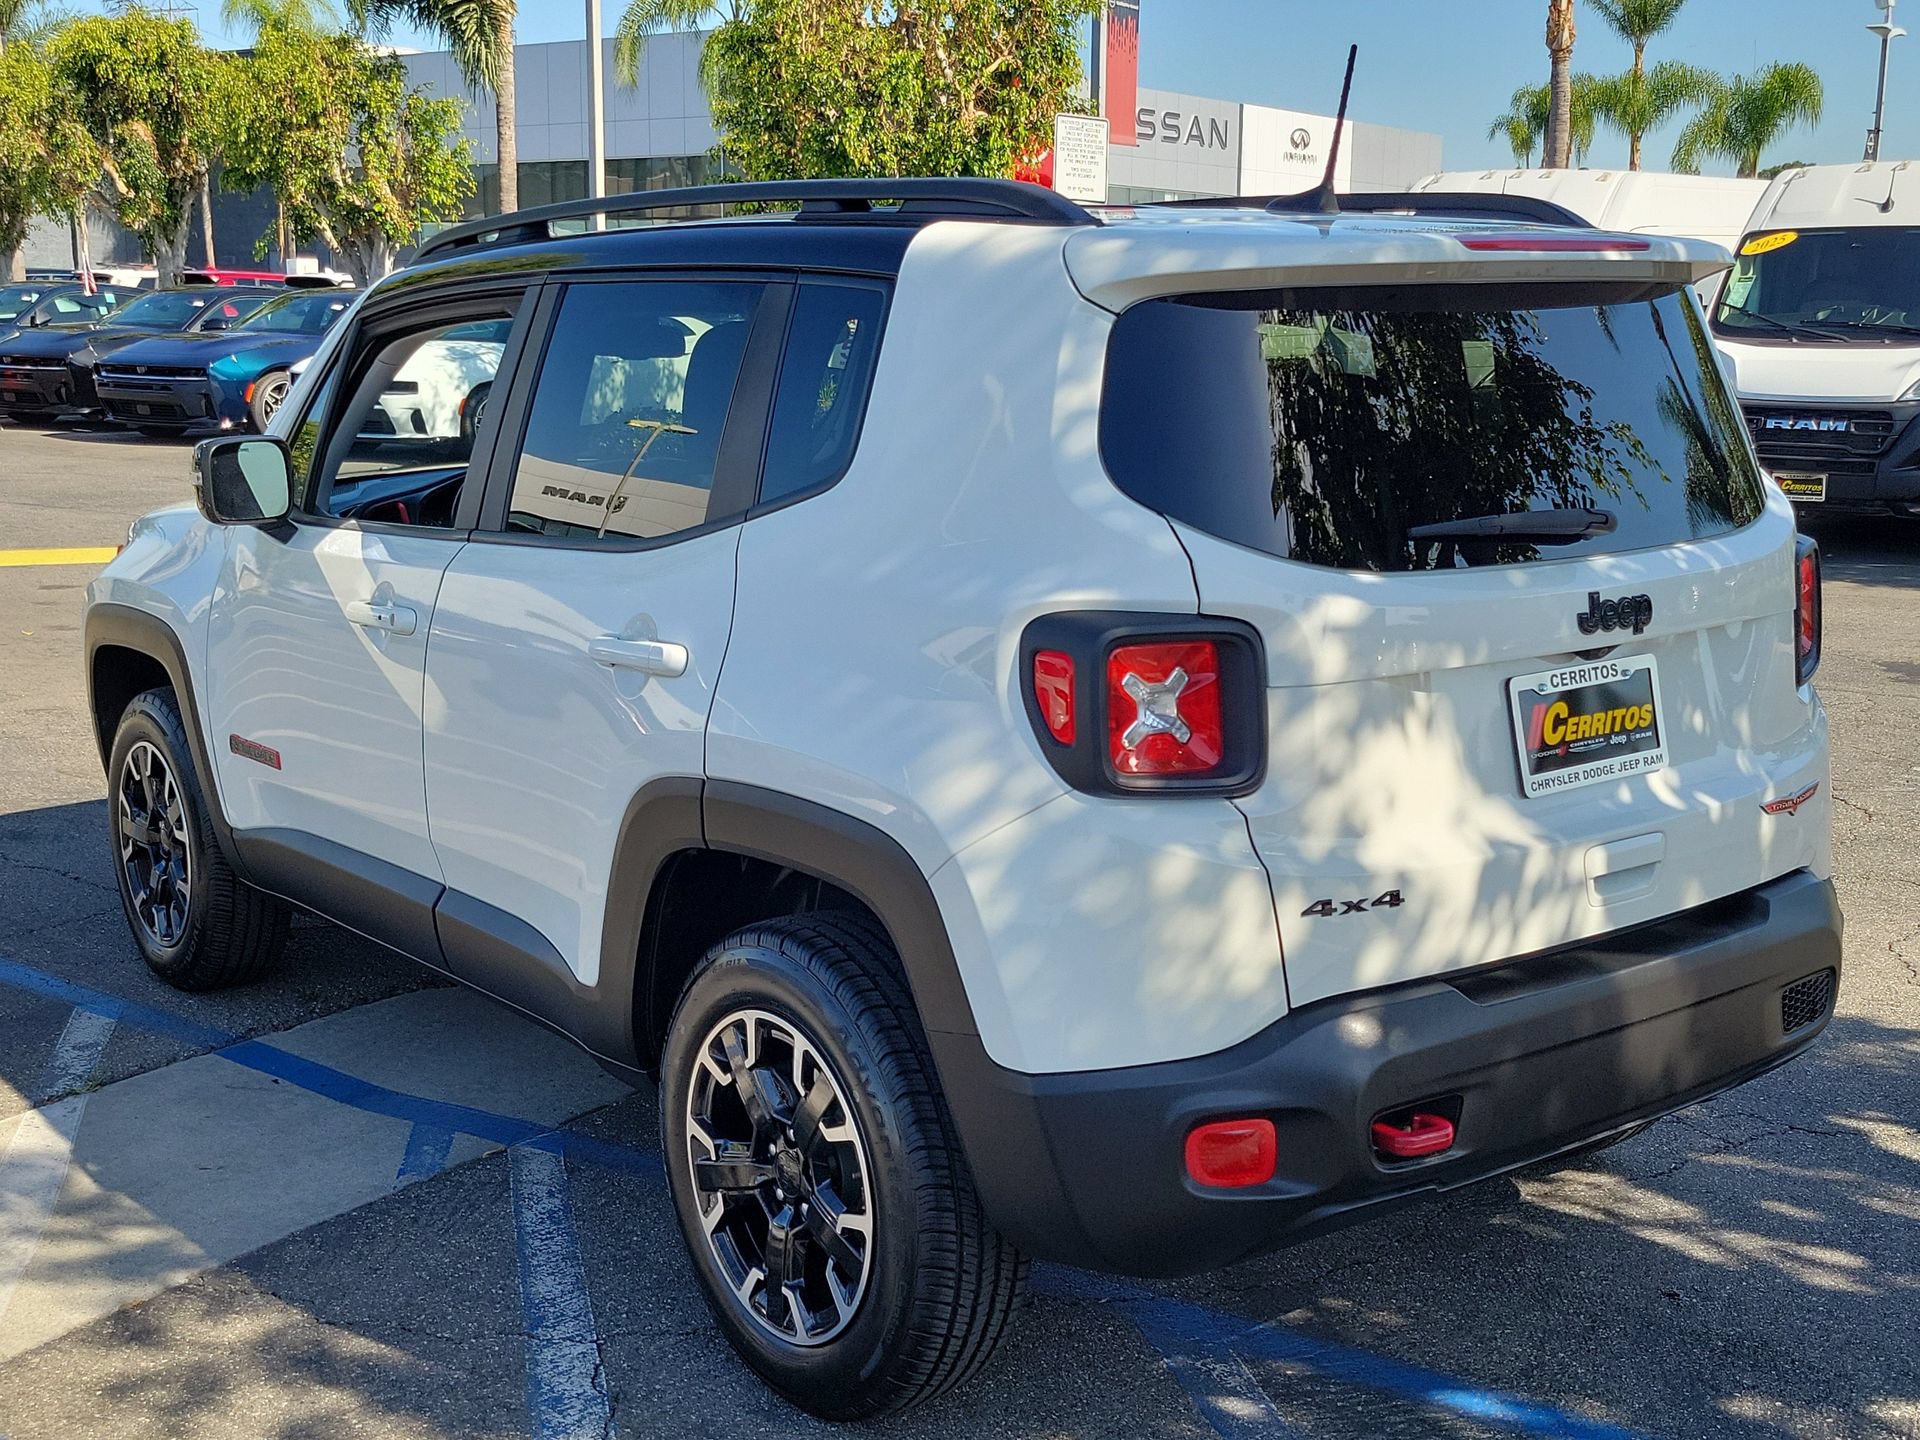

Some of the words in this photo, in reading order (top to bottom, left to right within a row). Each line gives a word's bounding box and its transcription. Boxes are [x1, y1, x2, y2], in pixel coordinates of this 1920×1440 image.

[1136, 107, 1229, 151] SSAN
[1751, 234, 1787, 252] 2025
[1765, 417, 1847, 431] RAM
[1577, 591, 1652, 636] Jeep
[1550, 663, 1618, 688] CERRITOS
[1543, 701, 1652, 745] CERRITOS
[1569, 738, 1605, 748] CHRYSLER
[1609, 734, 1627, 745] Jeep
[1531, 772, 1581, 792] CHRYSLER
[1583, 765, 1615, 781] DODGE
[1617, 759, 1641, 773] JEEP
[1643, 753, 1664, 767] RAM
